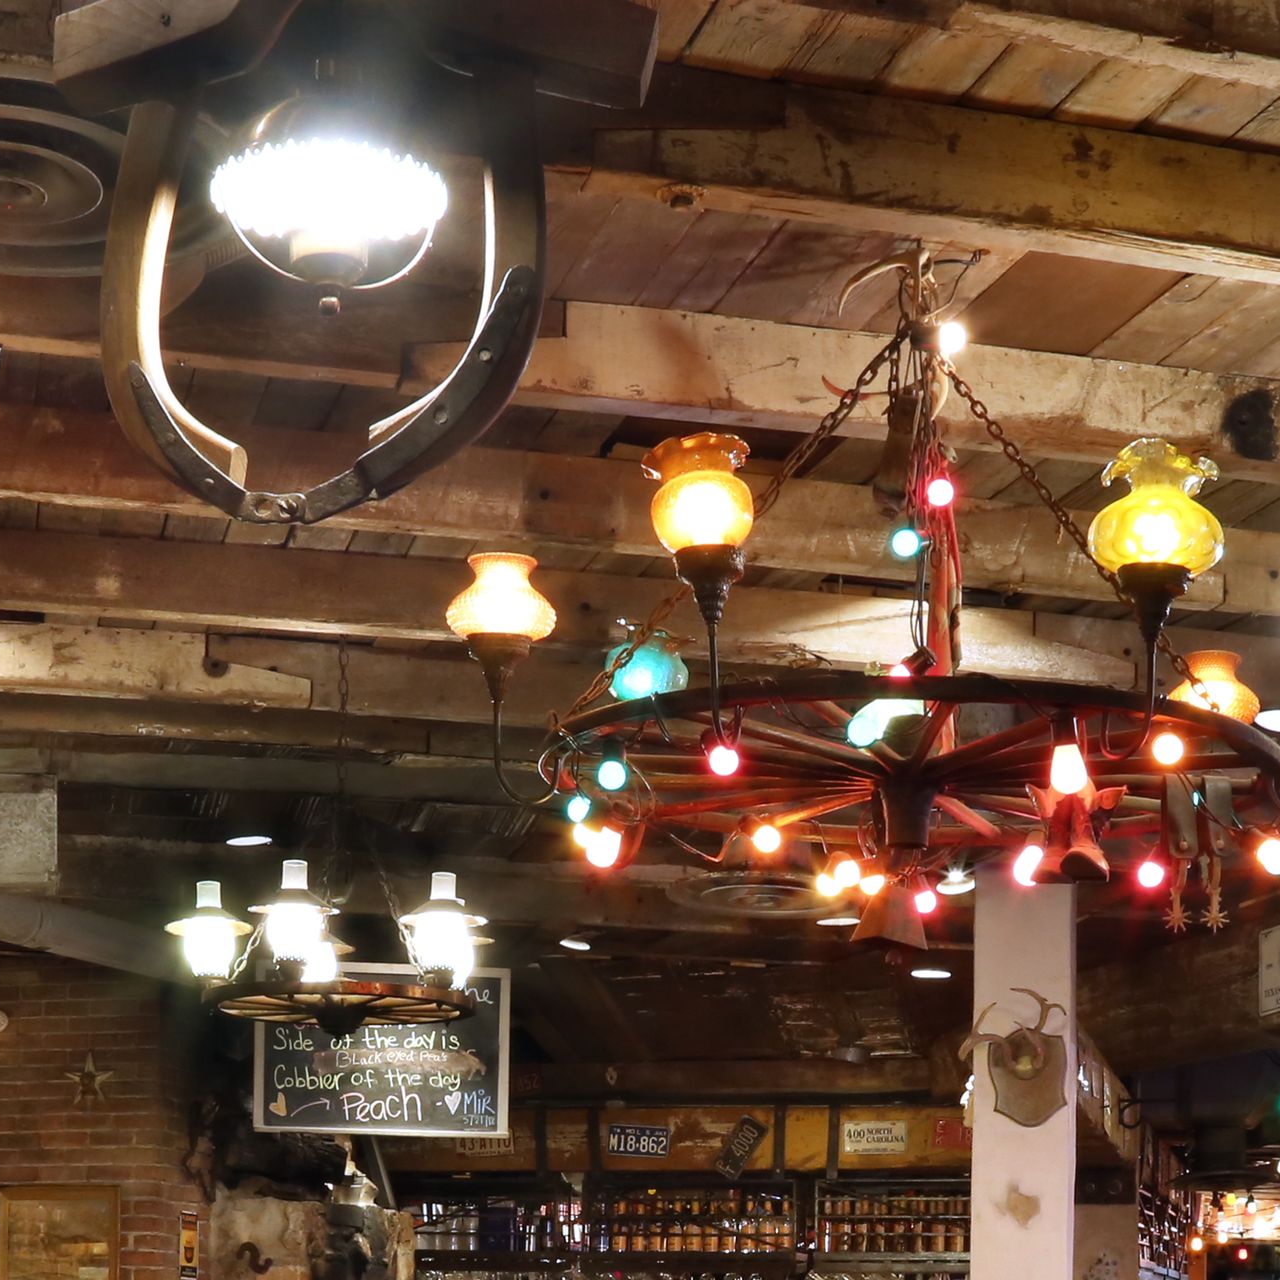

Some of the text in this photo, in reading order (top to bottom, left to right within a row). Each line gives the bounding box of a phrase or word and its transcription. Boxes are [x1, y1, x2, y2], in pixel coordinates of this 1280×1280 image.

[273, 1027, 314, 1051] Side
[362, 1028, 399, 1049] the
[404, 1030, 436, 1050] day
[441, 1029, 460, 1050] is
[350, 1069, 375, 1088] of
[384, 1068, 423, 1088] the
[429, 1072, 461, 1091] day
[340, 1085, 422, 1122] Peach
[866, 1127, 893, 1136] NORTH
[866, 1134, 906, 1144] CAROLINA
